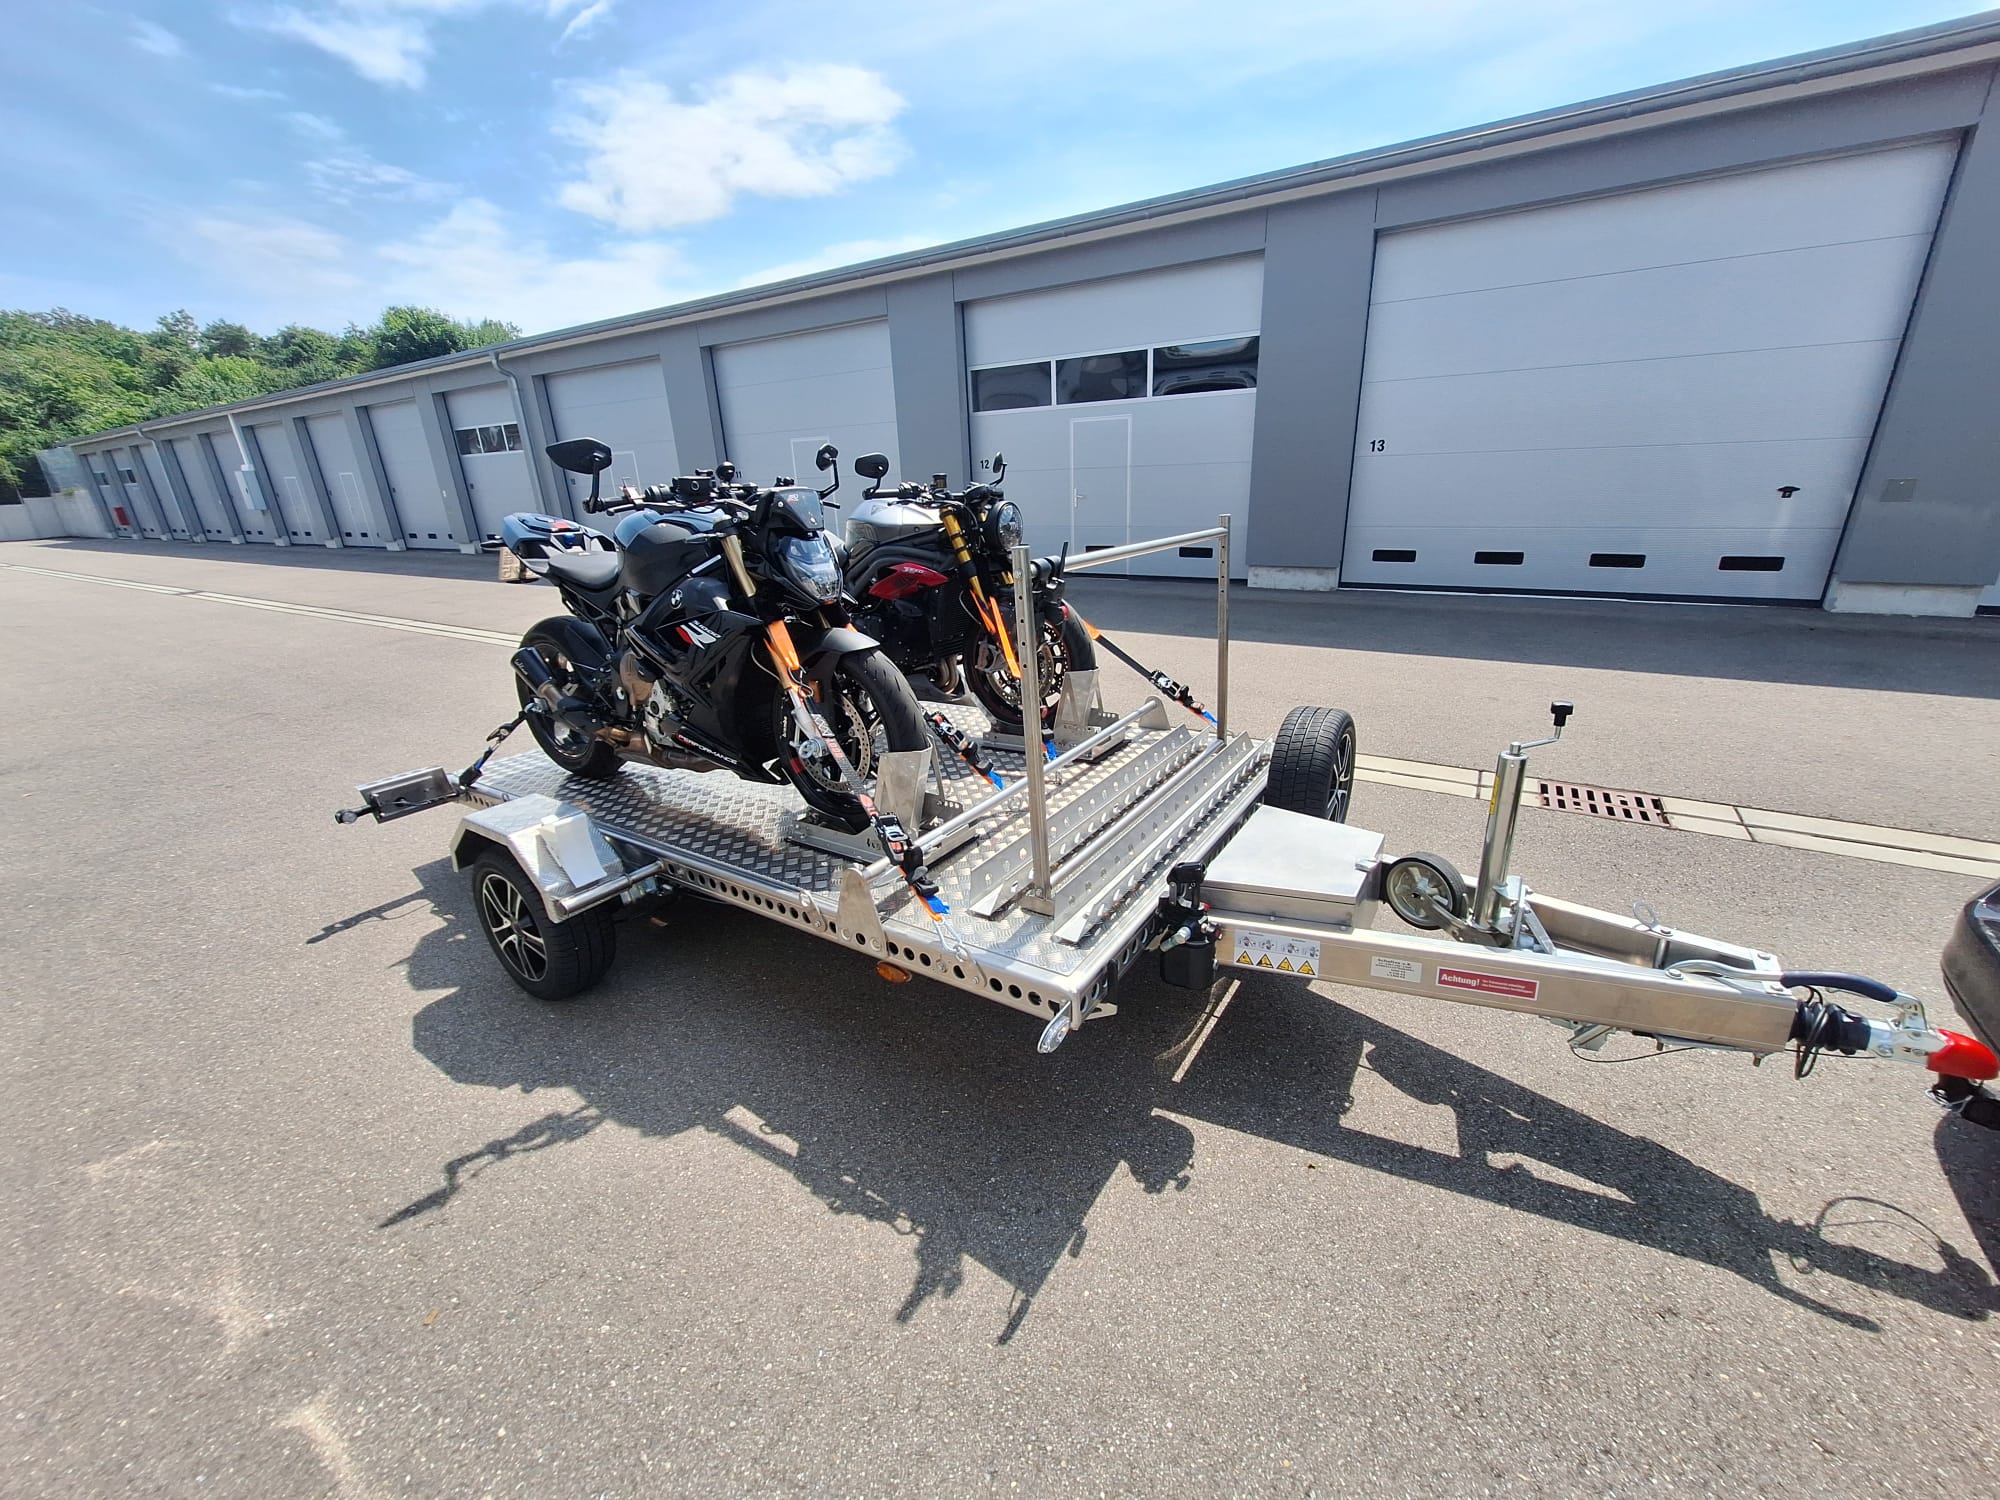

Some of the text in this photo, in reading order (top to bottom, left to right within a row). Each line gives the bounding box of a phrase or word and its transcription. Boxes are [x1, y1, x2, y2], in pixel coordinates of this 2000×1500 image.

[1370, 439, 1385, 452] 13
[980, 459, 990, 470] 12
[1441, 973, 1480, 987] Achtung!
